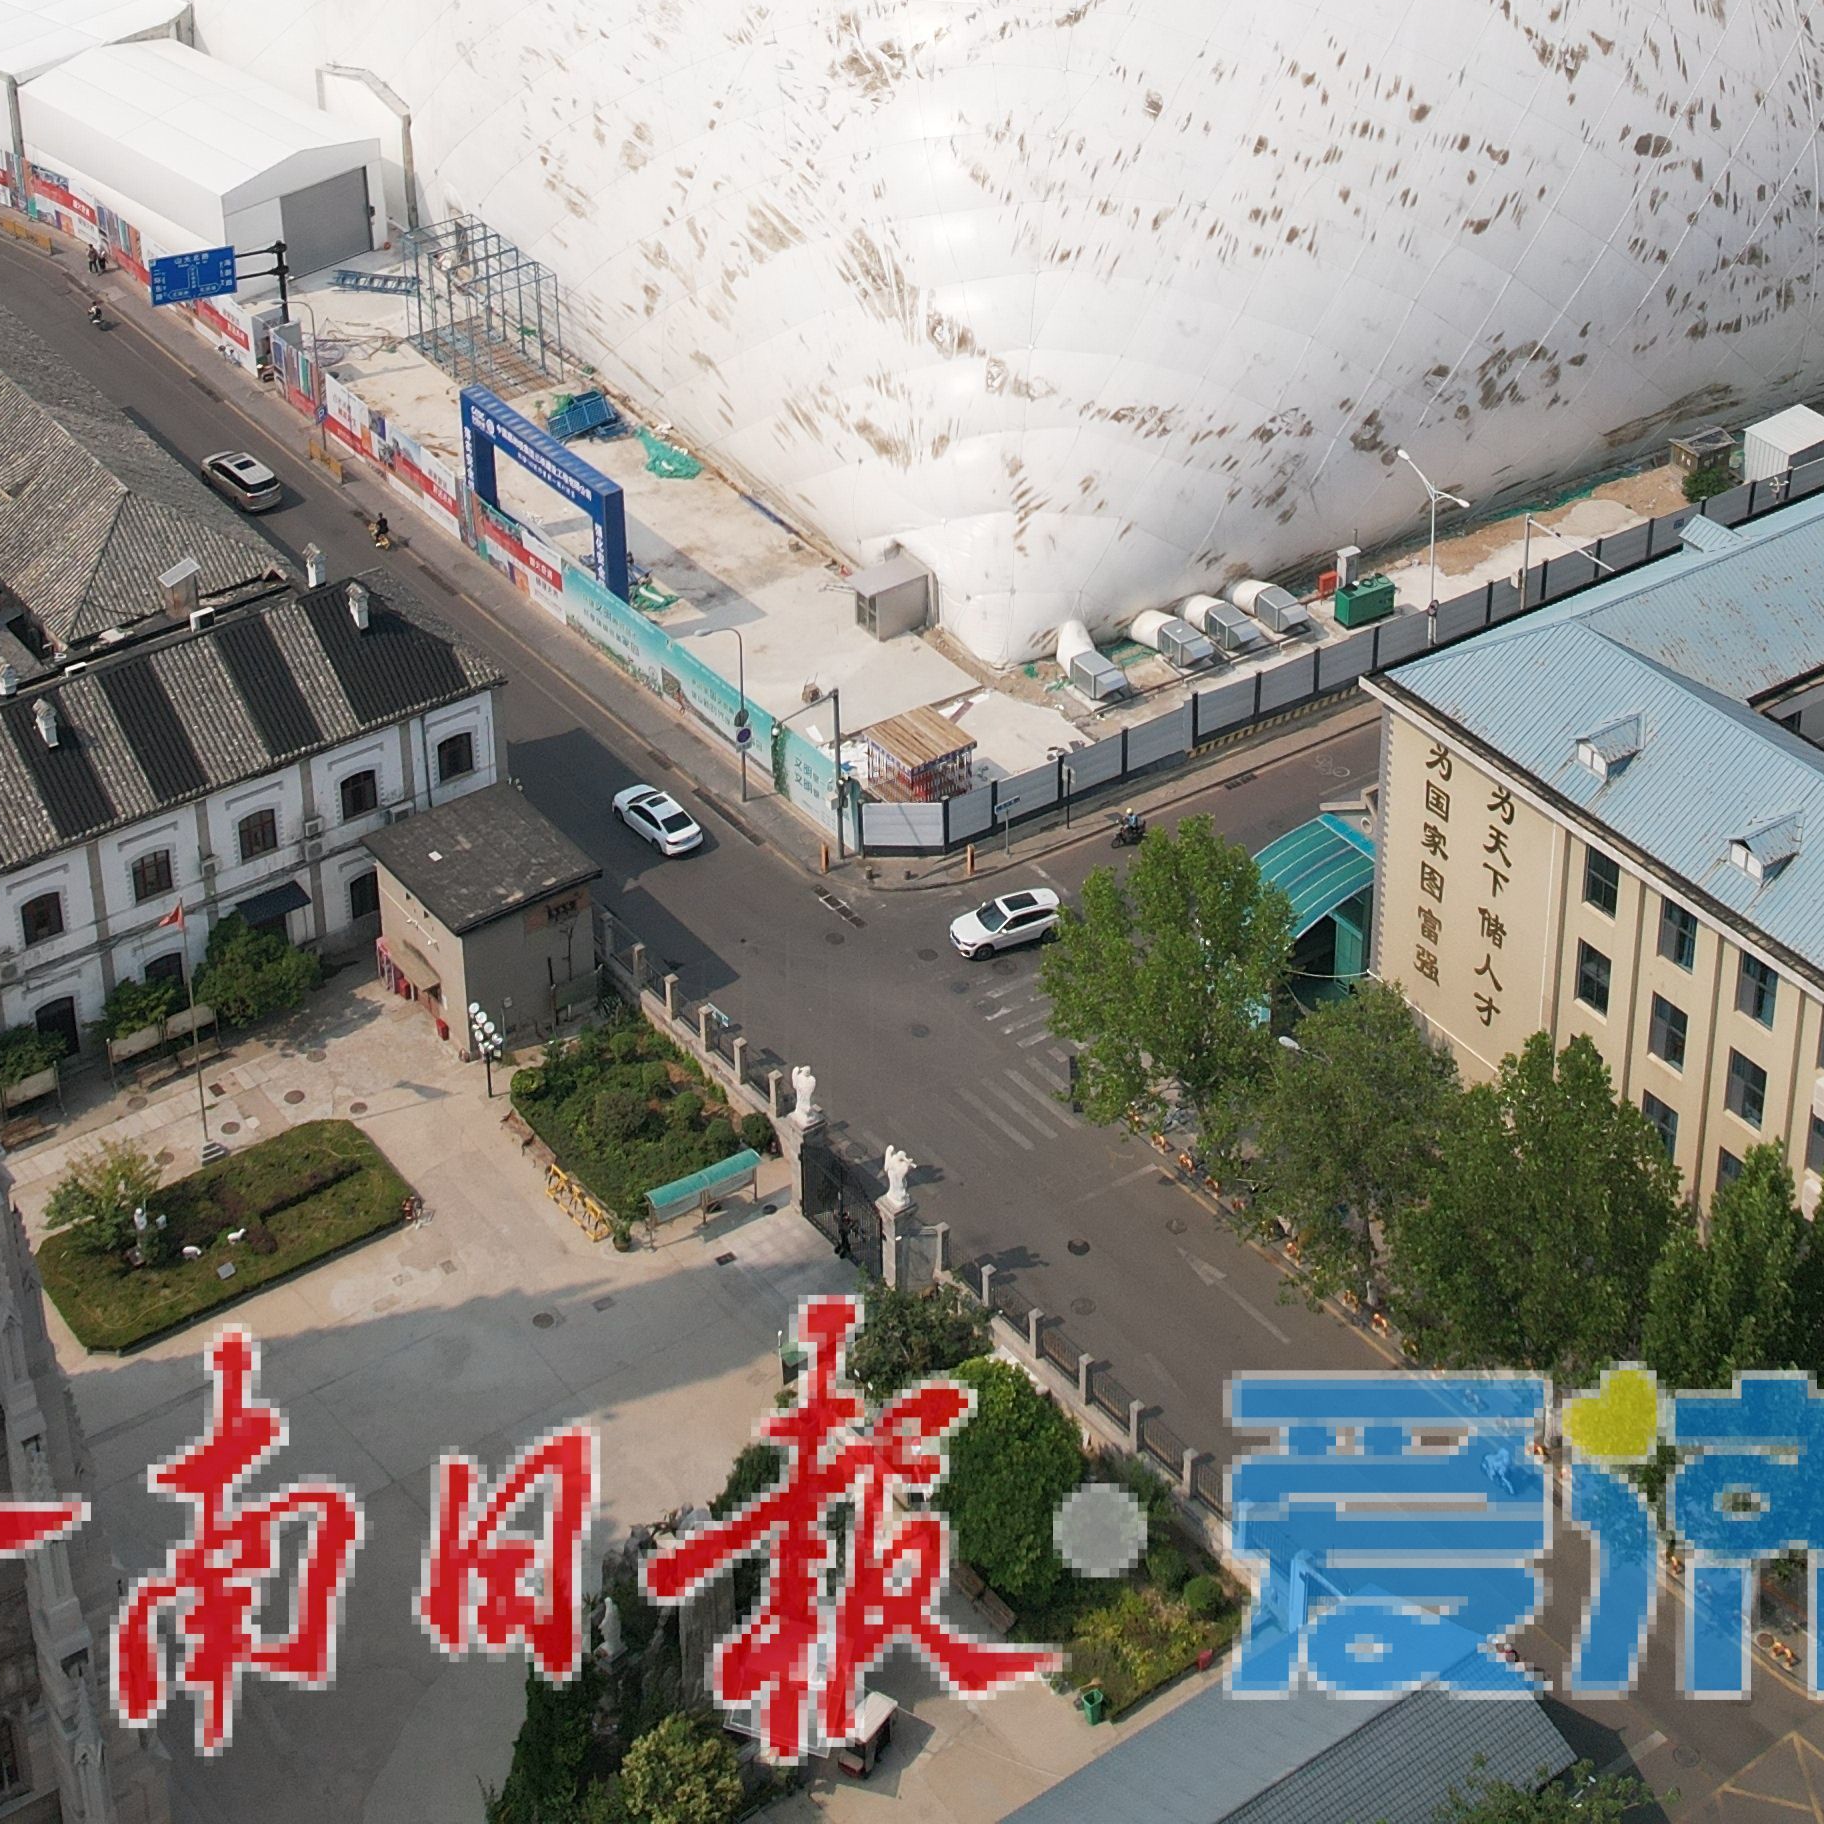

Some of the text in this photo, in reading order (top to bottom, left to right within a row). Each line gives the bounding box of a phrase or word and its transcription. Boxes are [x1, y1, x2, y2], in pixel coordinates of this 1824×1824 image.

[1412, 742, 1453, 988] 为国家图富强
[1473, 784, 1516, 1028] 为天下储人才
